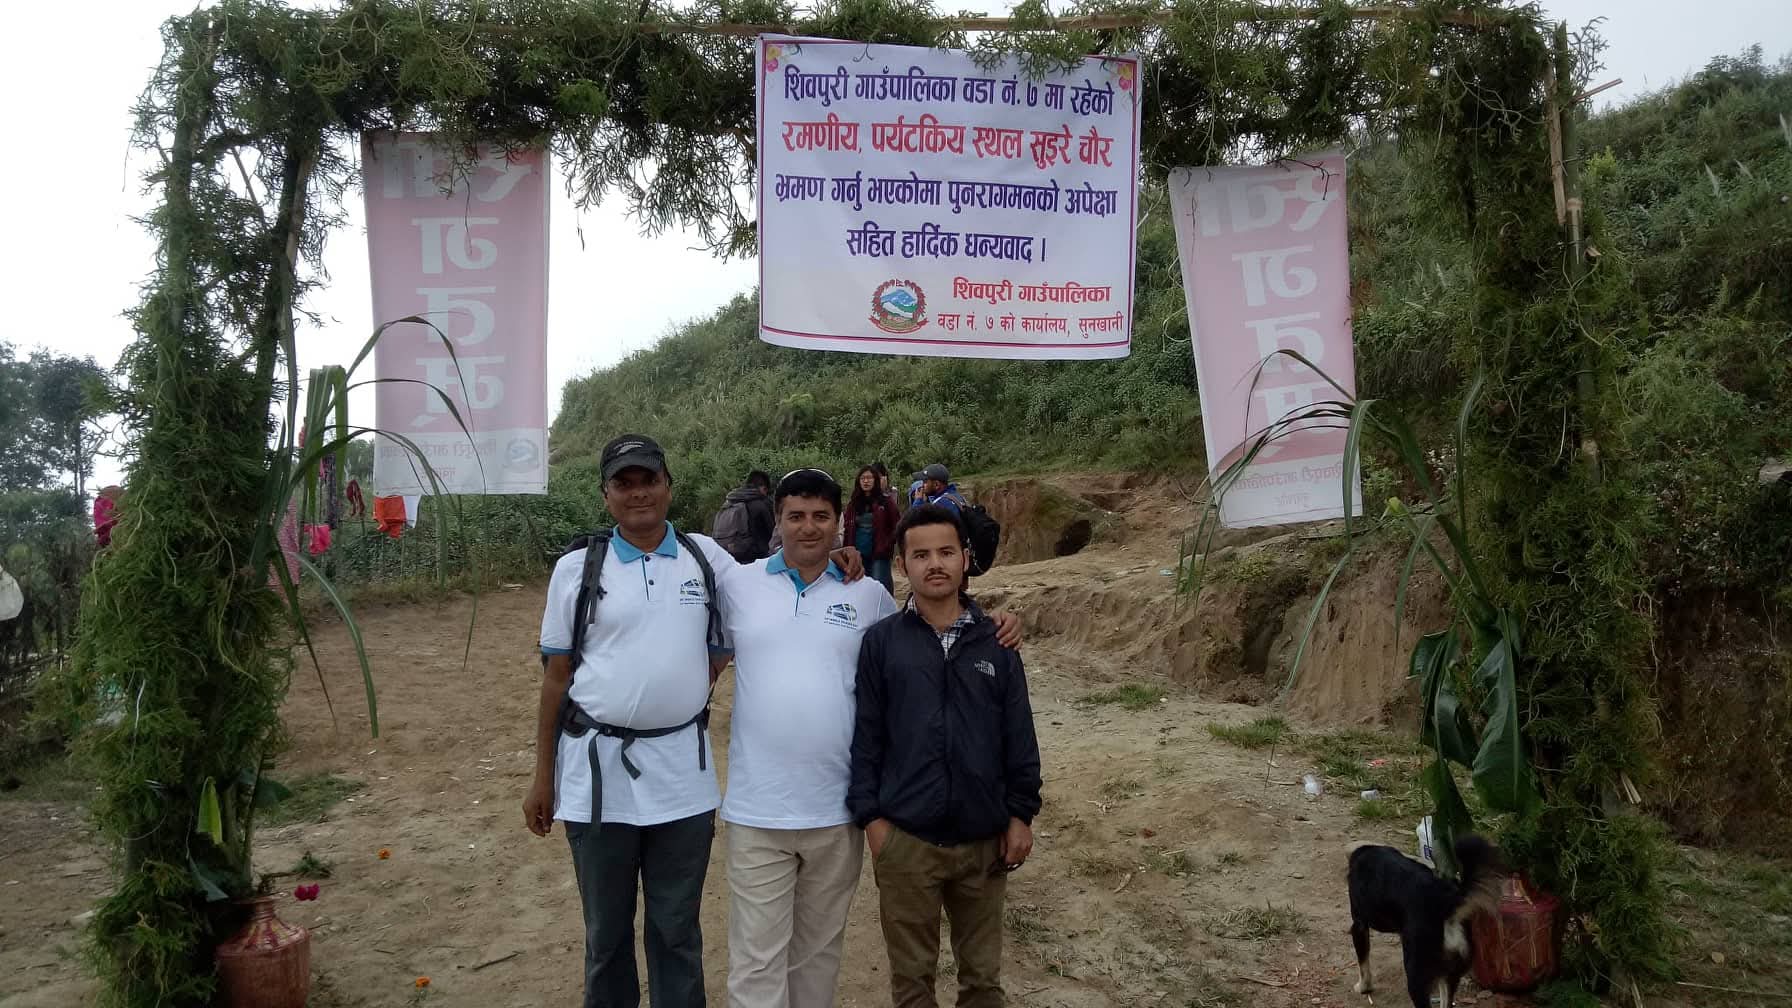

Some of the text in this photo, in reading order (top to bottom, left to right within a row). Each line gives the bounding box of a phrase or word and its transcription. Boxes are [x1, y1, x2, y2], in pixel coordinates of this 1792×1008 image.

[785, 64, 1115, 115] शिवपुरी गाउँपालिका वडा नं. ७ मा रहेको
[782, 112, 1114, 169] रमणीय, पर्यटकिय स्थल सुइरे चौर
[775, 170, 1118, 218] भ्रमण गर्नु भएकोमा पुनरागमनको अपेक्षा
[846, 220, 896, 258] सहित
[901, 222, 960, 259] हार्दिक
[965, 233, 1034, 264] धन्यवाद
[953, 276, 1112, 304] शिवपुरी गाउँपालिका
[937, 313, 960, 331] वडा
[985, 314, 994, 330] ७
[1000, 311, 1015, 332] को
[1021, 312, 1071, 337] कार्यालय,
[1078, 310, 1124, 339] सुनखानी
